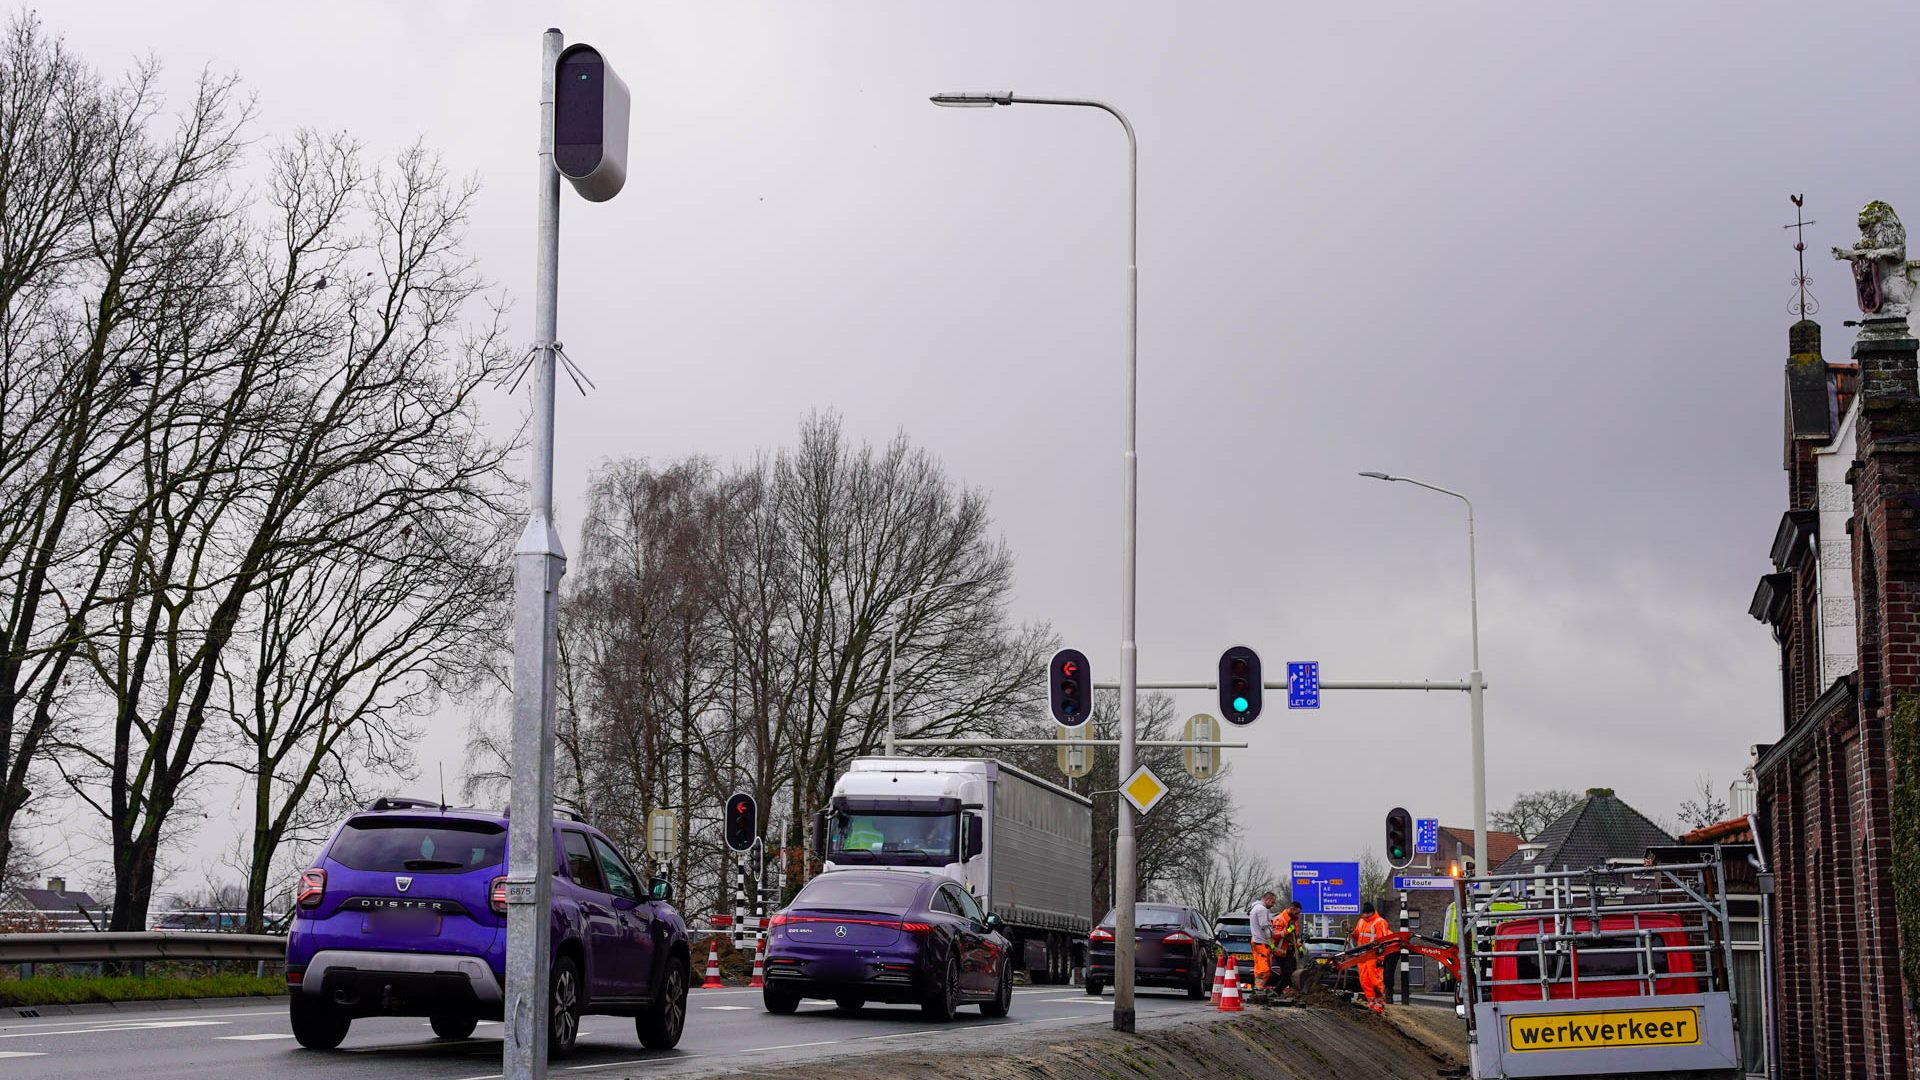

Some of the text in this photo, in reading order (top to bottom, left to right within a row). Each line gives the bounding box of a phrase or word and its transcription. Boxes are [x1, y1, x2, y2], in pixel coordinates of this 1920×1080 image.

[510, 887, 532, 896] 6875
[361, 900, 441, 909] DUSTER
[1520, 1018, 1687, 1044] werkverkeer
